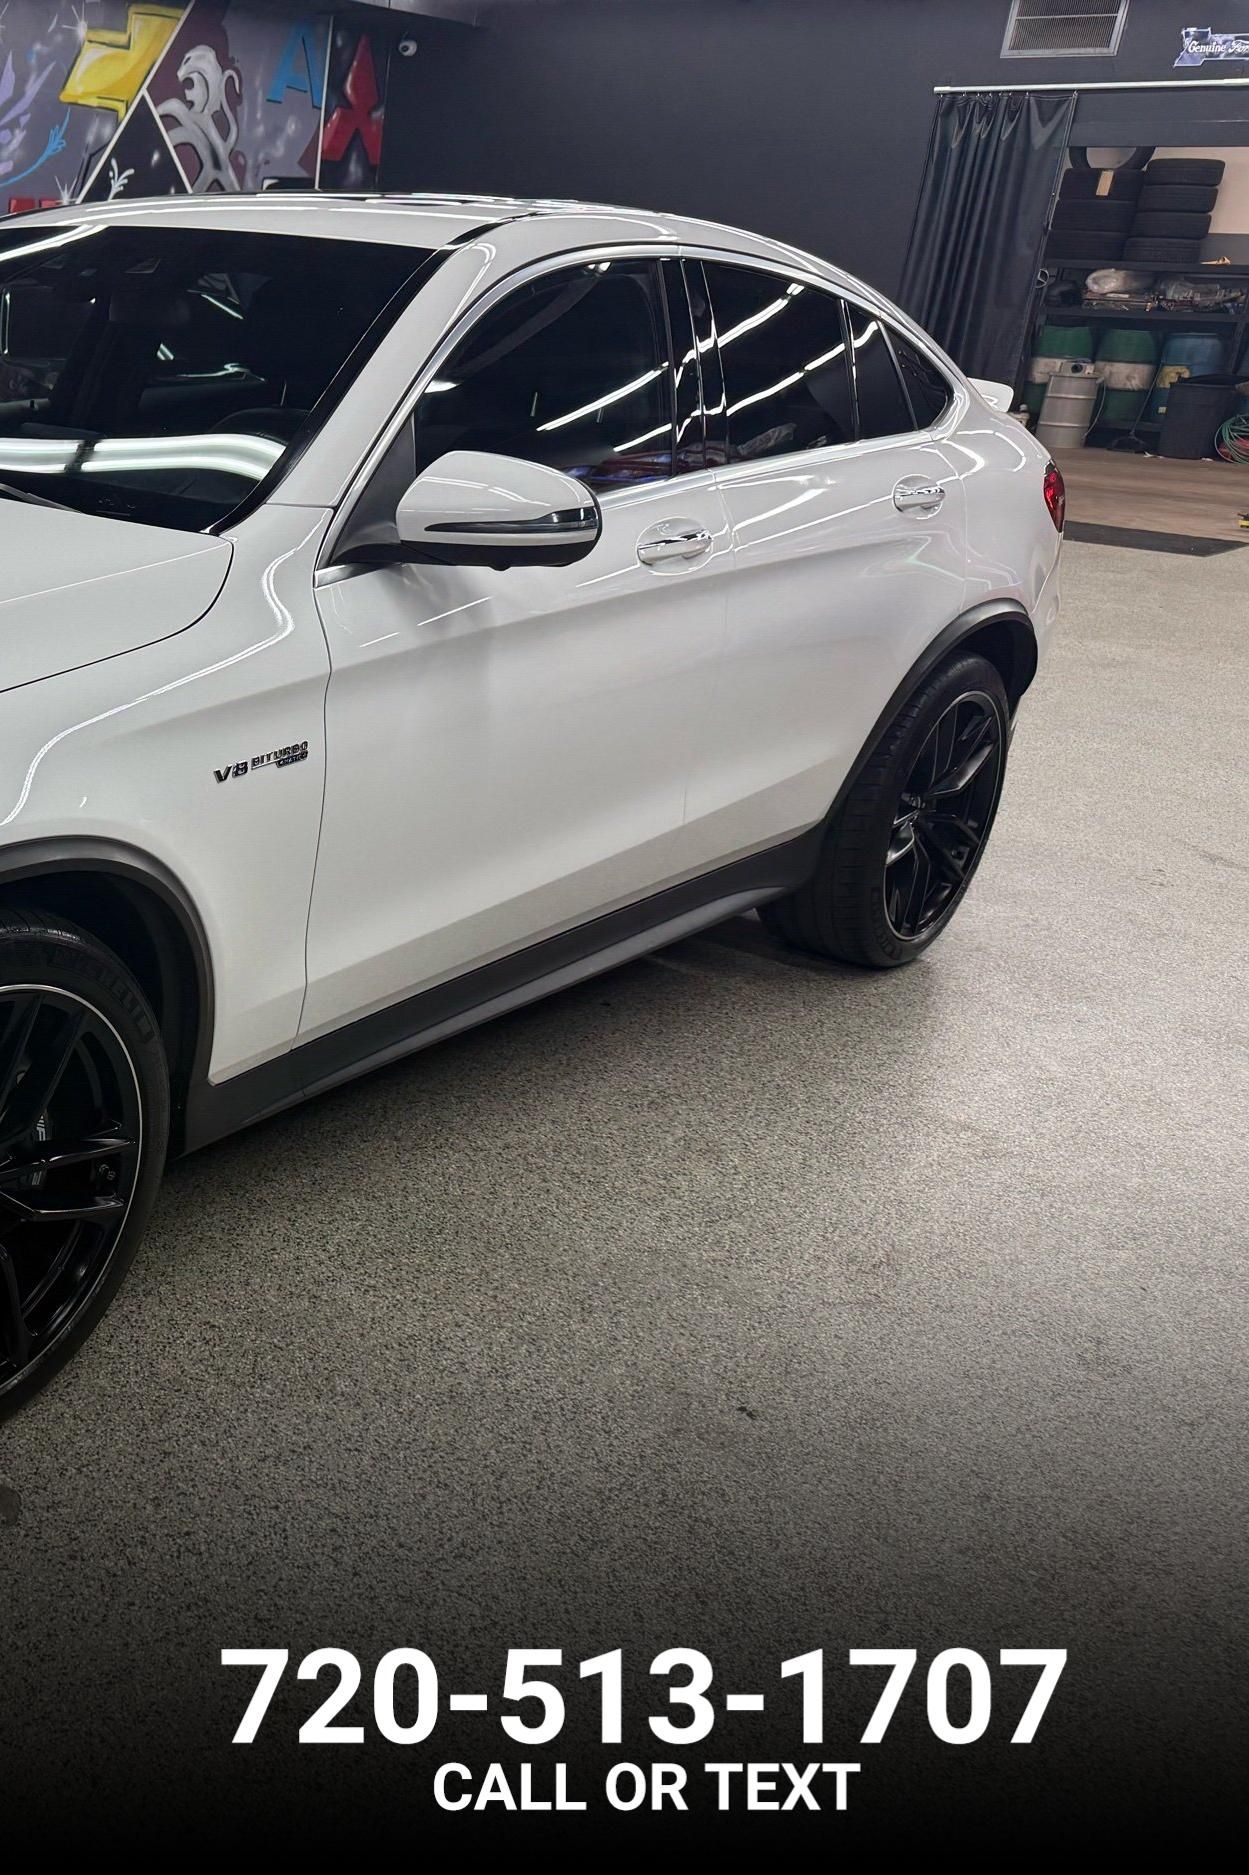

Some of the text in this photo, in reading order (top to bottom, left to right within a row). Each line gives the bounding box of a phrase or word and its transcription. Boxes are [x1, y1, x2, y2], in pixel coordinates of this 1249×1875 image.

[1188, 40, 1226, 53] Genuine
[213, 741, 308, 783] V8 BITURBO
